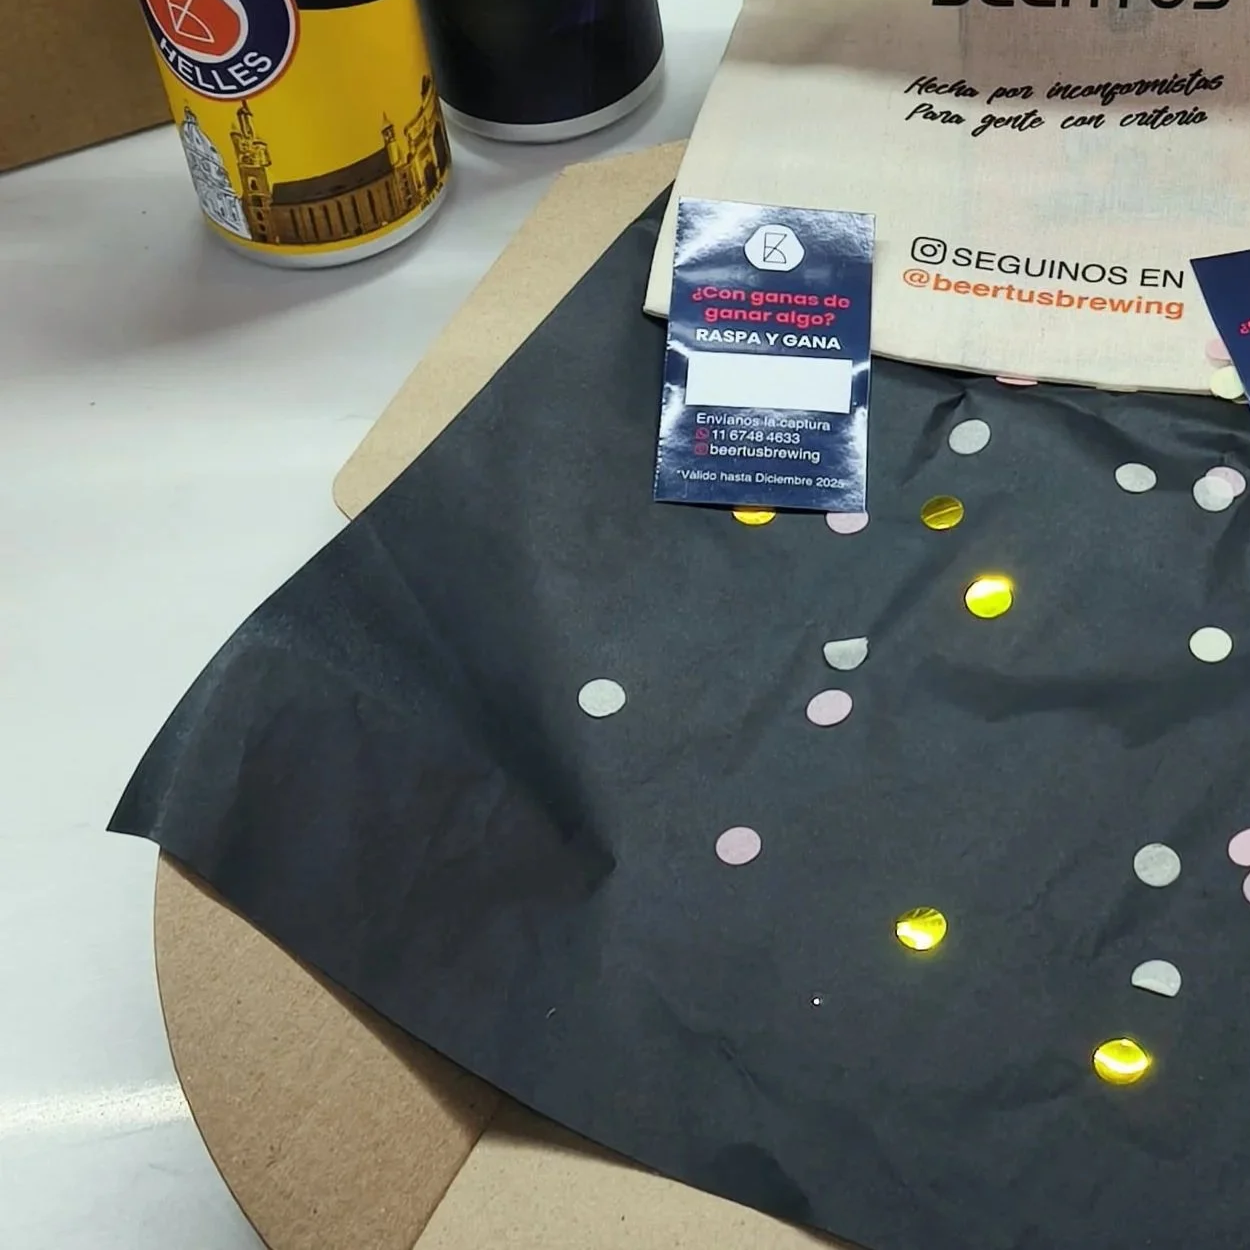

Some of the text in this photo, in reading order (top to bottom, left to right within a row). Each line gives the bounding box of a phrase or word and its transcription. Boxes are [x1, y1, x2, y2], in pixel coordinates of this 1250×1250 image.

[159, 37, 272, 91] HELLES
[904, 68, 1224, 106] Hecha por inconformistas
[905, 103, 1208, 137] Para gente con criterio
[952, 247, 1185, 289] SEGUINOS EN
[692, 286, 850, 308] ¿Con ganas de
[903, 268, 1184, 320] @beertusbrewing
[704, 306, 836, 329] ganar algo?
[696, 328, 841, 350] RASPA Y GANA
[763, 415, 831, 434] la captura
[712, 429, 801, 444] 11 6748 4633
[709, 443, 821, 463] beertusbrewing
[720, 471, 845, 489] hasta Diciembre 2025
